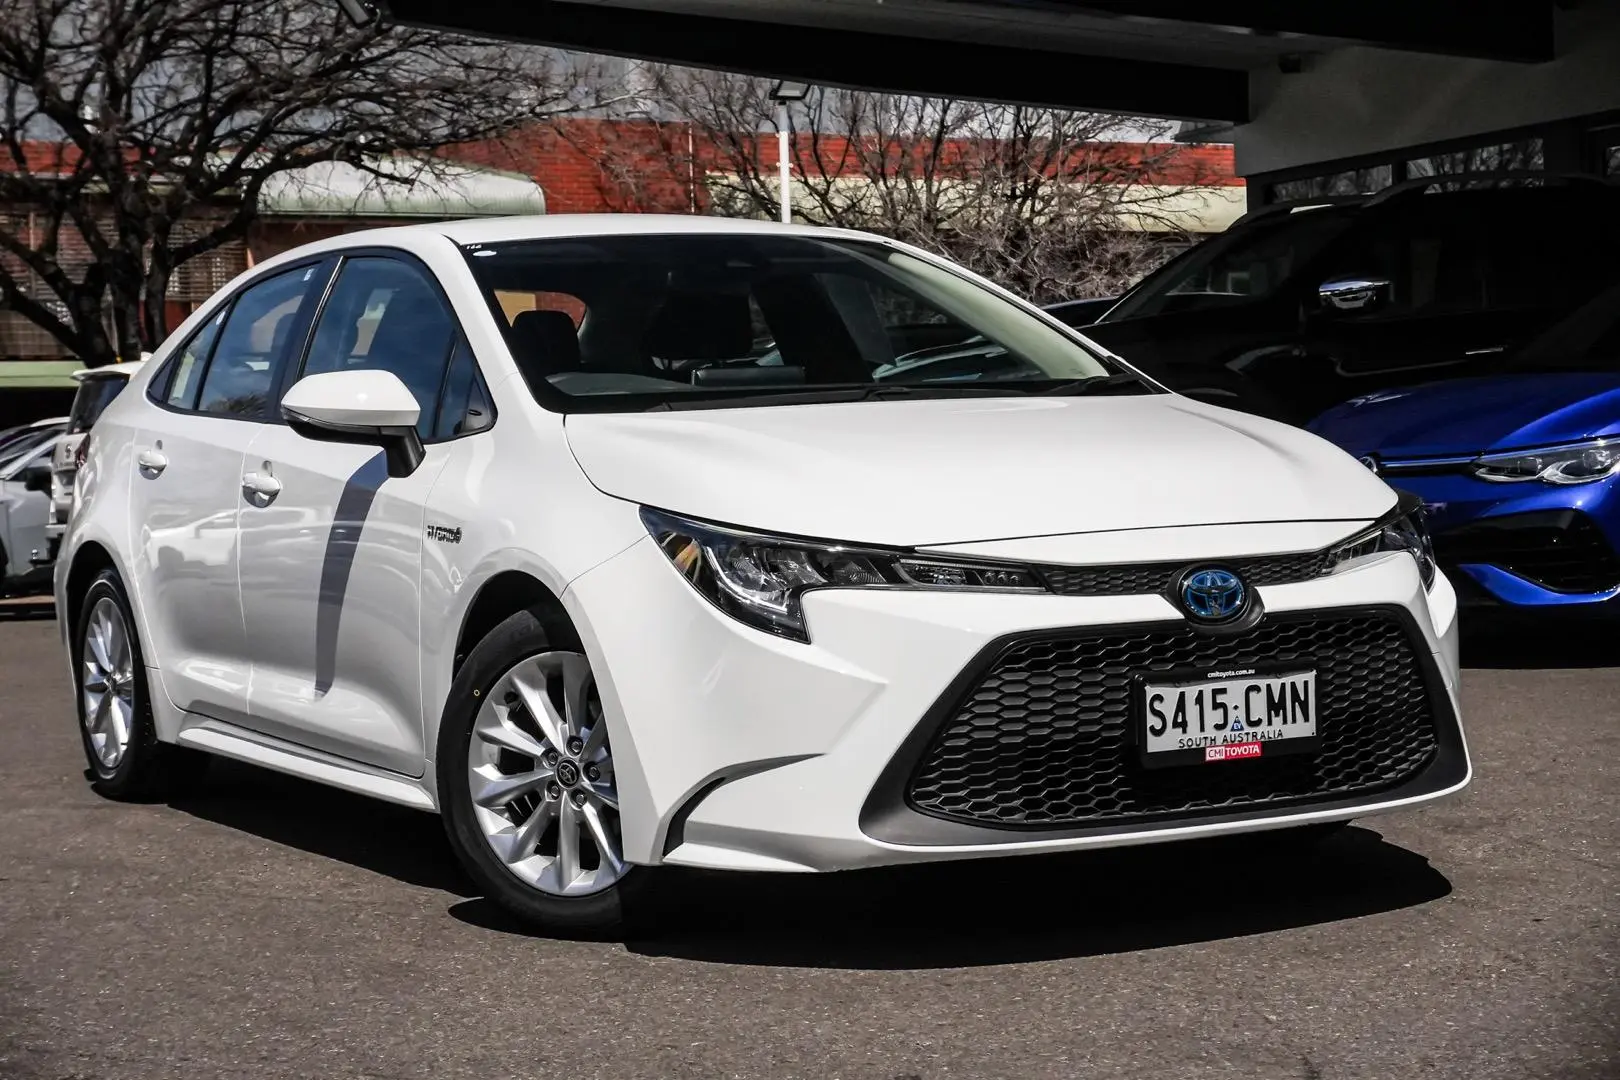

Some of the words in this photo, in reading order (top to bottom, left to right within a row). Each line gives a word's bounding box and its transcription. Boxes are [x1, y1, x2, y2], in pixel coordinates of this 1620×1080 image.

[1178, 736, 1217, 748] SOUTH
[1222, 729, 1284, 744] AUSTRALIA
[1208, 748, 1224, 758] CMI
[1225, 745, 1260, 756] TOYOTA
